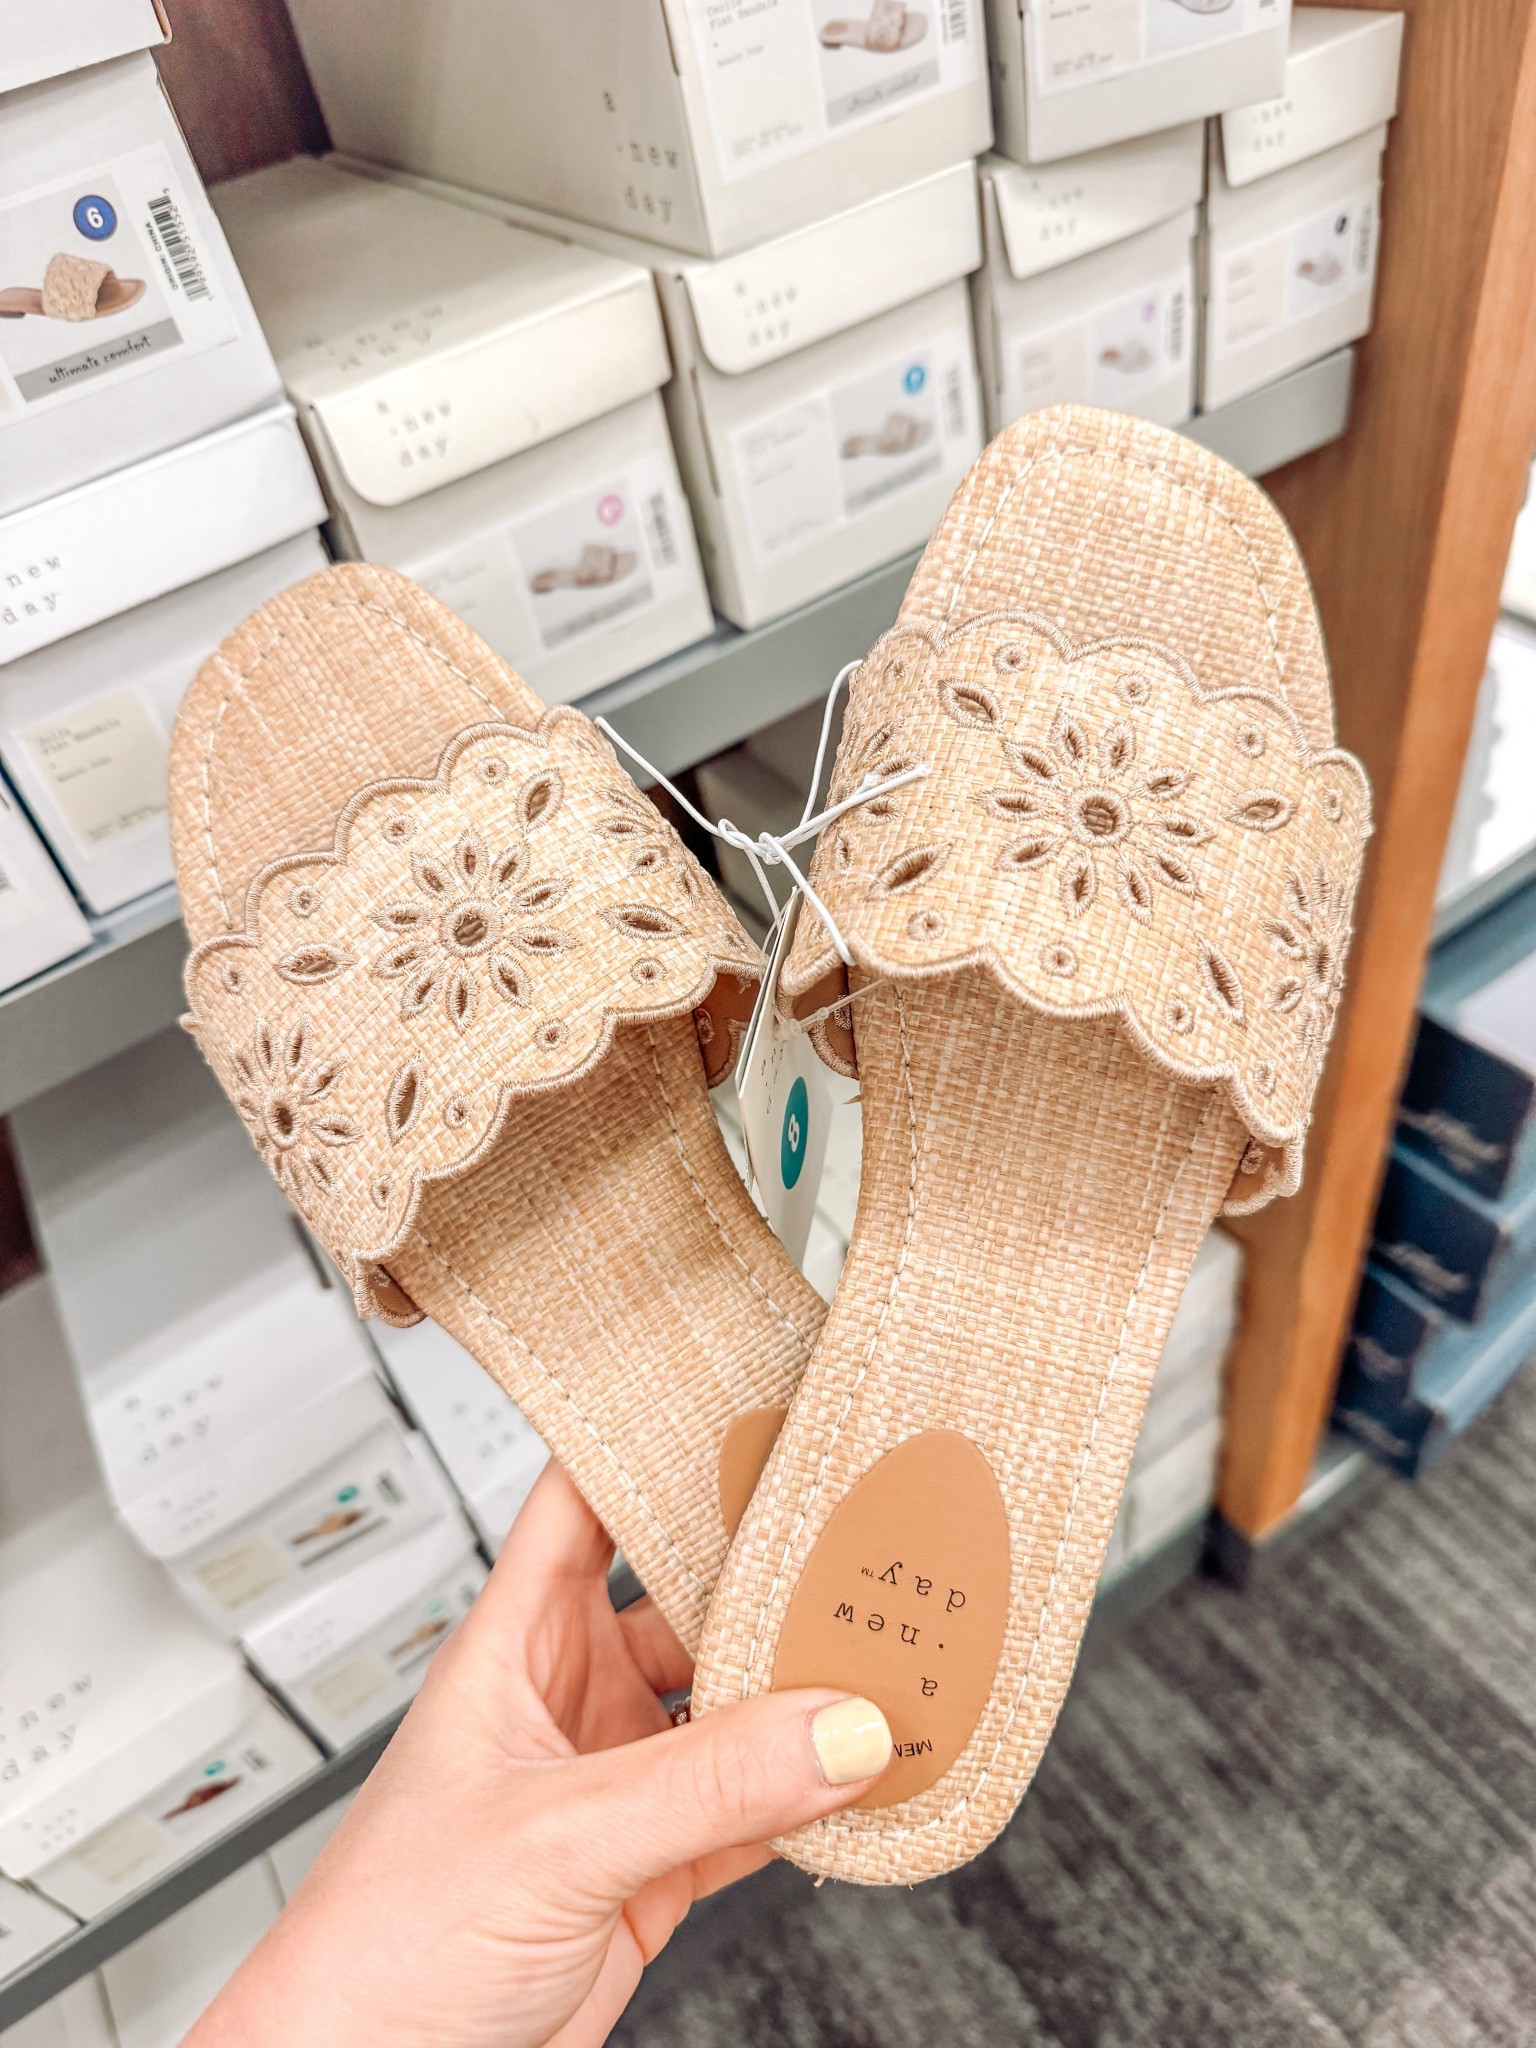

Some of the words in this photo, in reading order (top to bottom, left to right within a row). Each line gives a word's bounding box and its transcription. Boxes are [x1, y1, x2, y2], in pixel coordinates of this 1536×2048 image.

[86, 206, 104, 229] 6
[145, 221, 162, 252] CHINA
[49, 355, 100, 385] ultimate
[103, 335, 152, 364] comfort
[787, 1113, 800, 1153] 8
[921, 1677, 938, 1697] a
